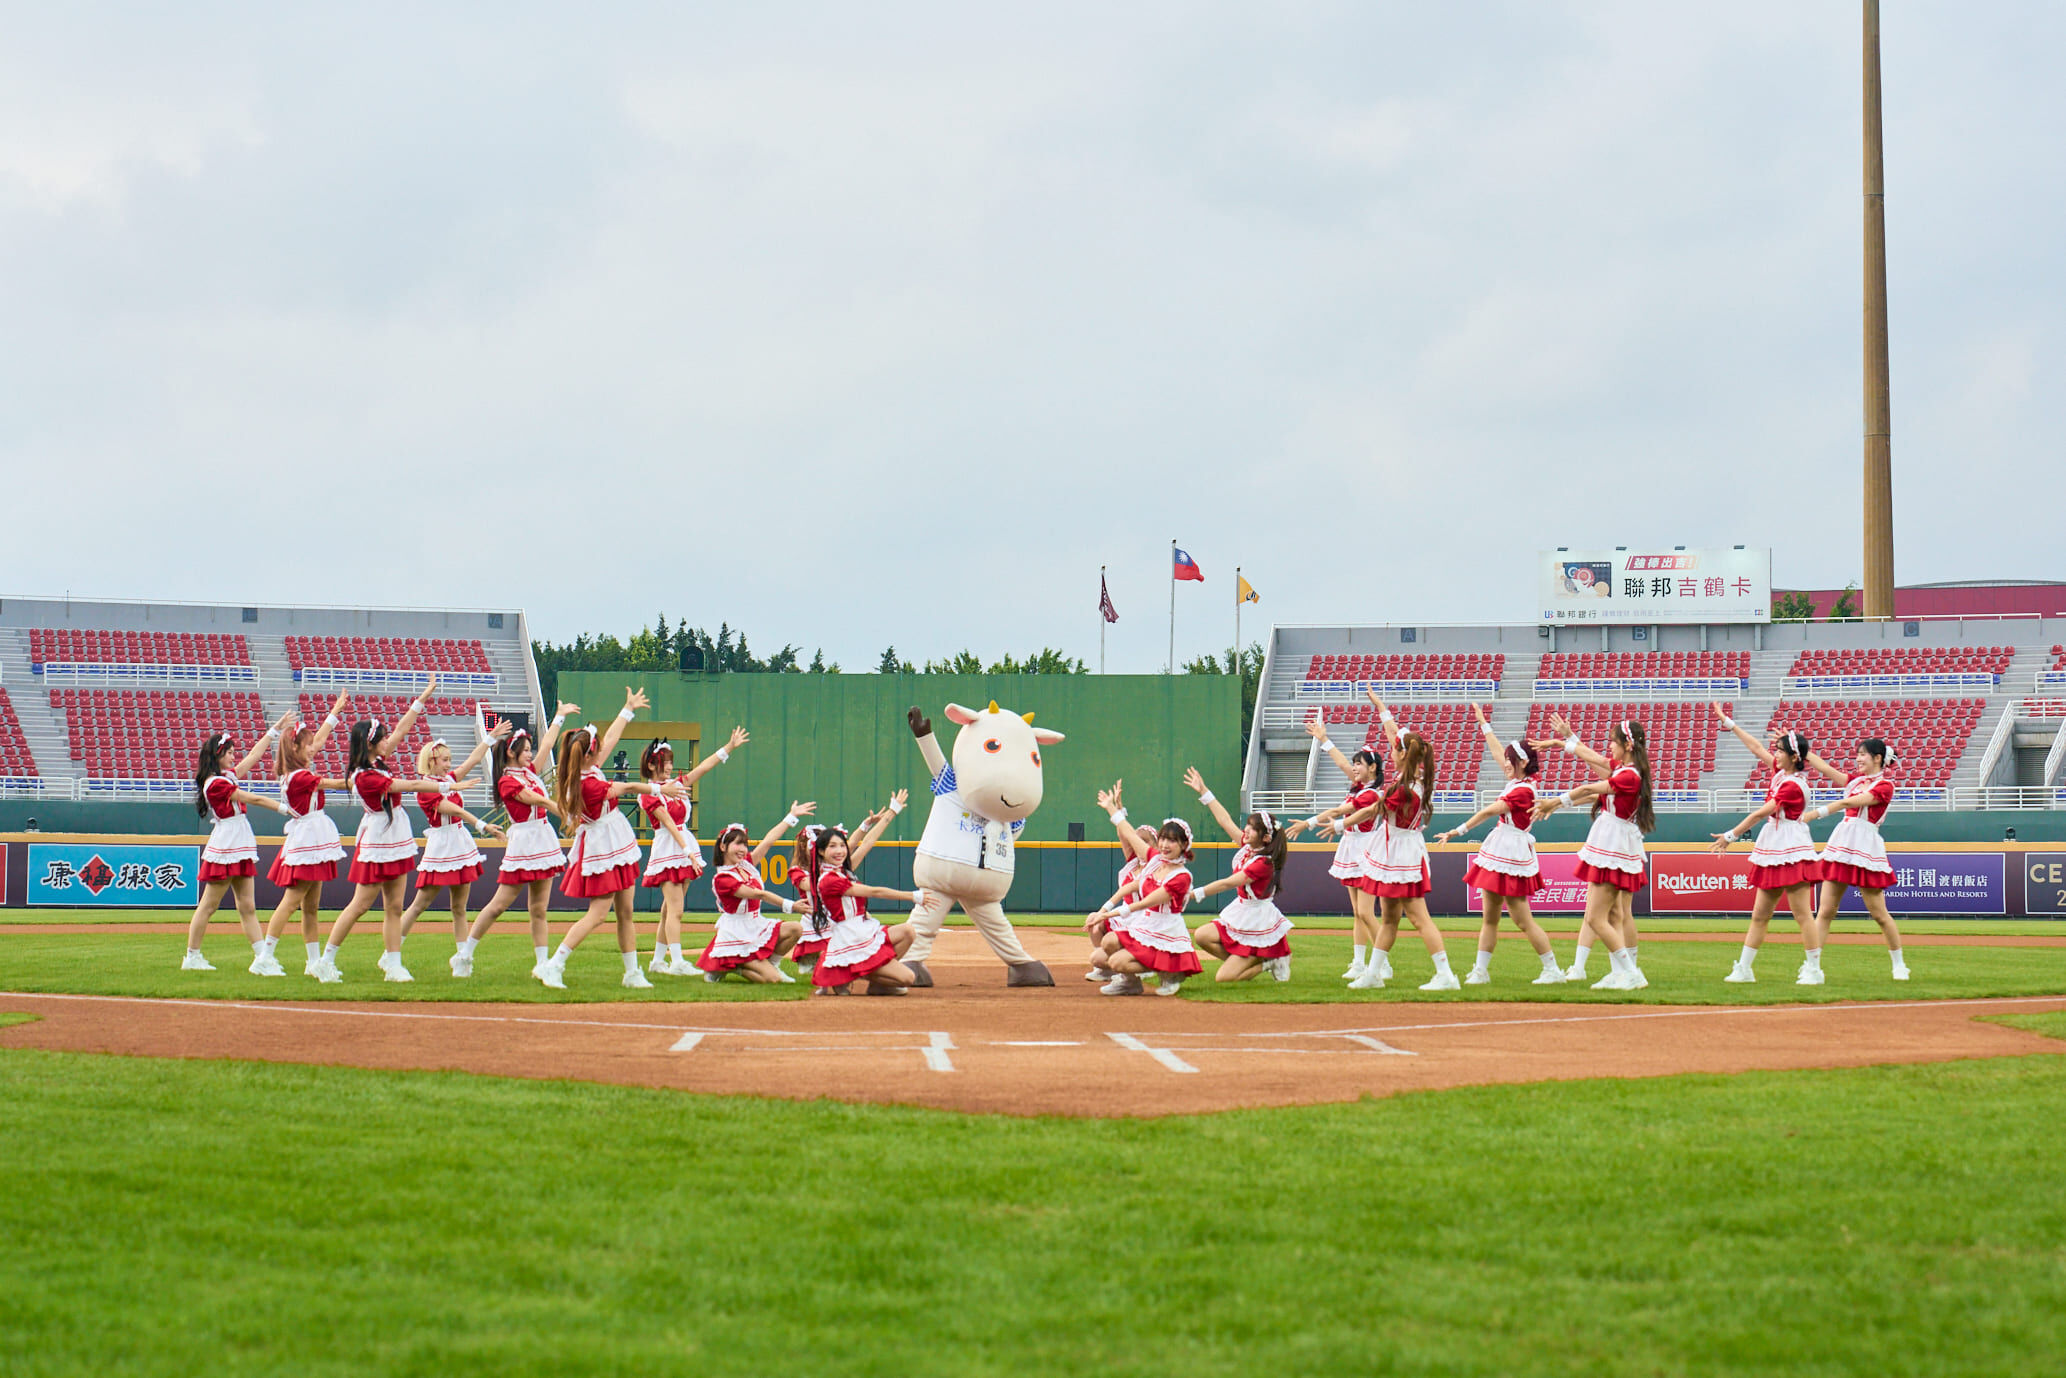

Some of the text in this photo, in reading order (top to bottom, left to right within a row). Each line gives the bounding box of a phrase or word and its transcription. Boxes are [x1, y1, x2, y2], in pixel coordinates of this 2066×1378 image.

[1624, 576, 1752, 598] 聯邦吉鶴卡
[1634, 626, 1646, 640] B
[996, 842, 1007, 858] 35
[42, 861, 186, 890] 康福搬家
[1657, 872, 1754, 890] Rakuten 樂
